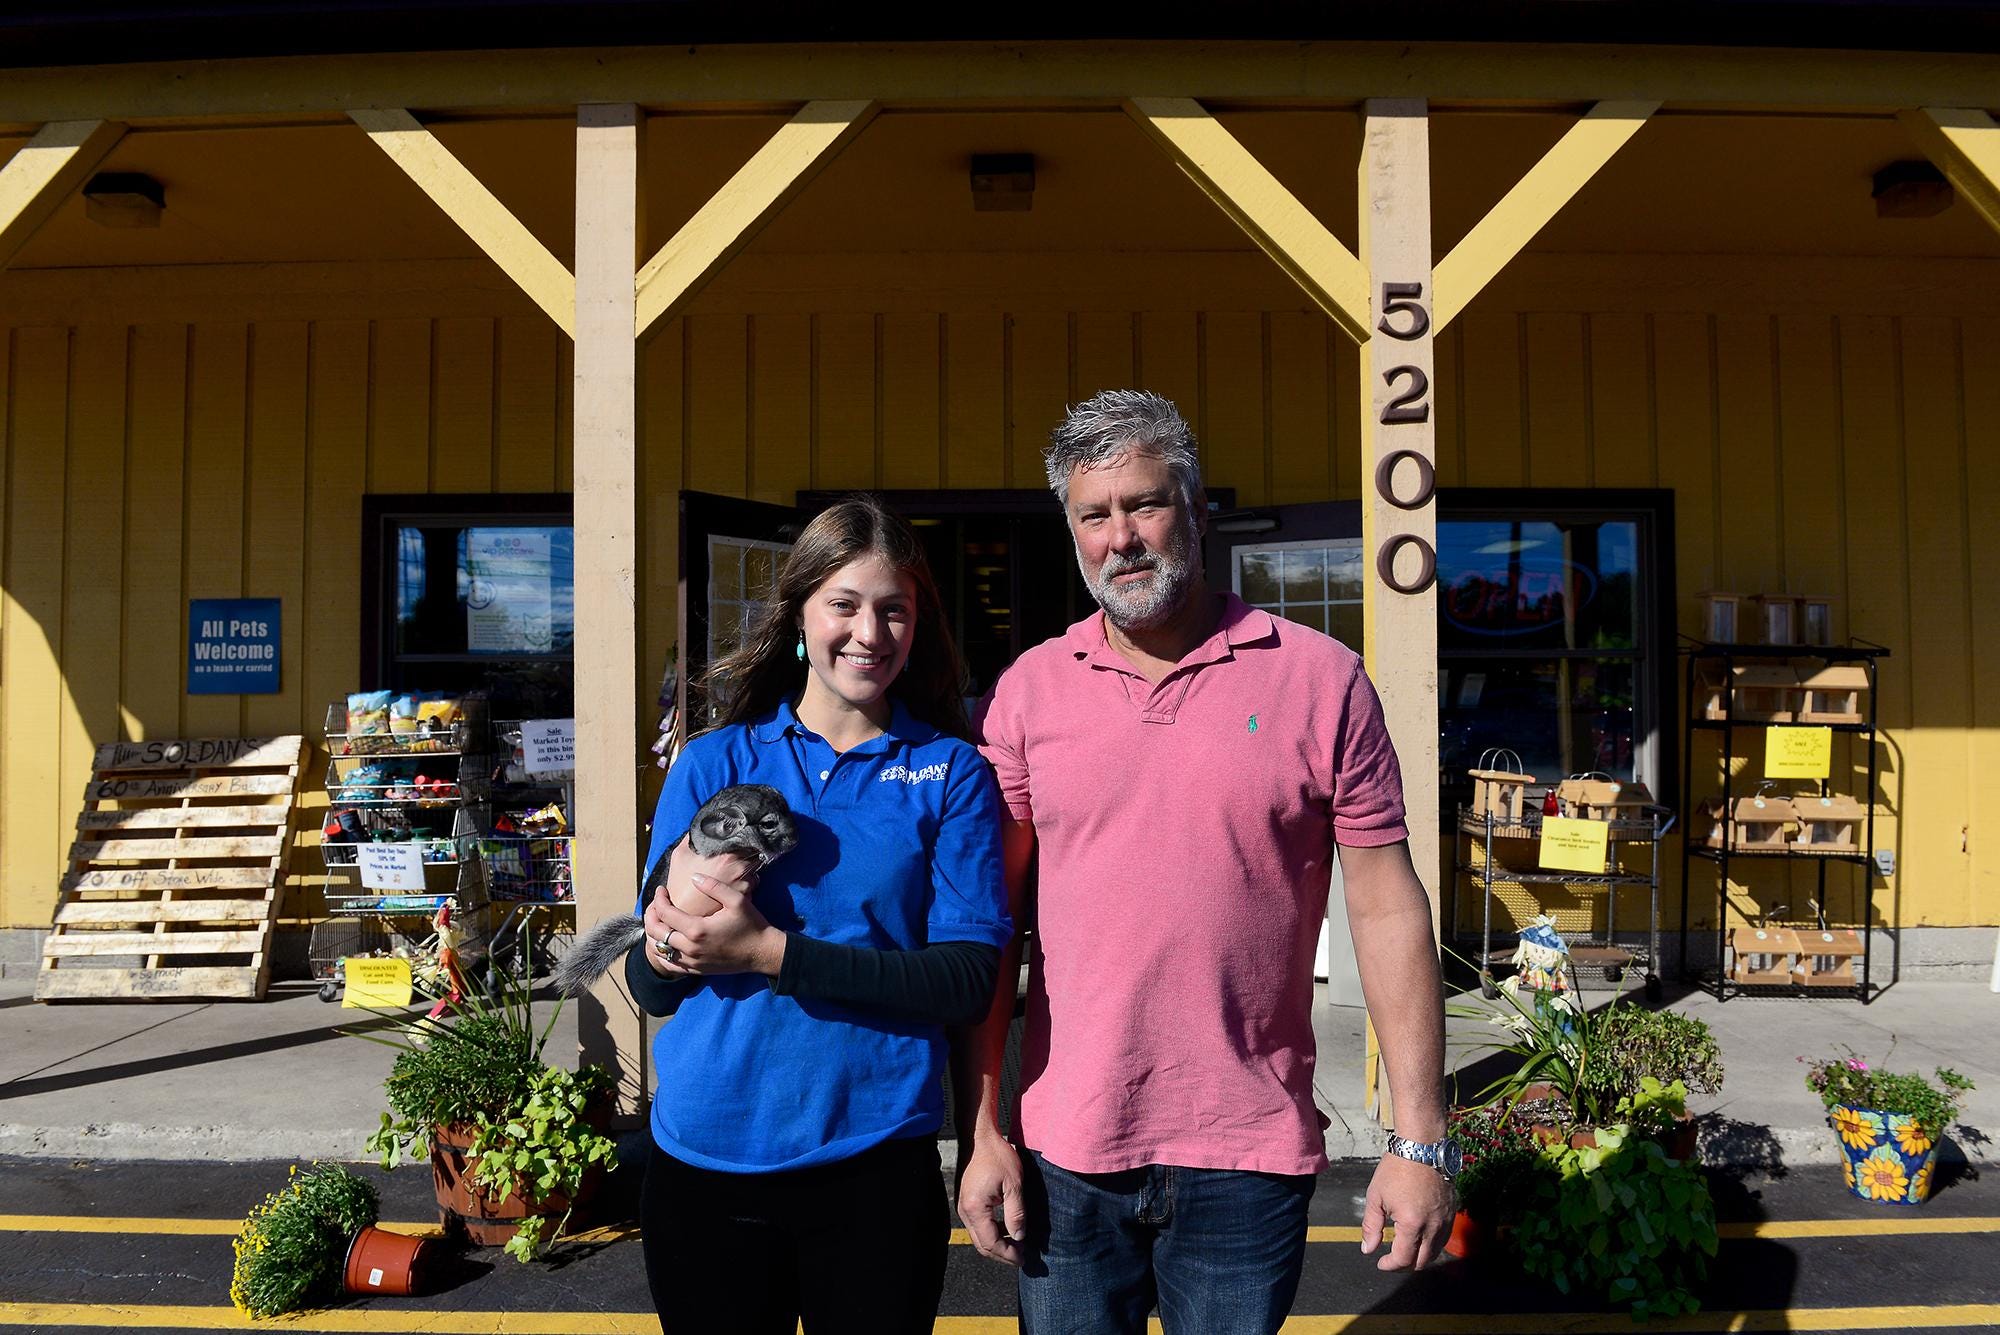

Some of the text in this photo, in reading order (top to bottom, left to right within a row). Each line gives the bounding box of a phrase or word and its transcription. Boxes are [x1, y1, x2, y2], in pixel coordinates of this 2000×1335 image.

[1375, 282, 1437, 595] 5200
[1447, 569, 1585, 622] OPEN
[201, 620, 268, 638] All Pets
[194, 642, 274, 660] Welcome
[213, 664, 233, 673] leash
[235, 664, 243, 673] or
[245, 663, 273, 672] carried
[532, 737, 559, 745] Marked
[546, 728, 562, 736] Sale
[141, 739, 261, 765] SOLDAN'S
[537, 755, 552, 763] only
